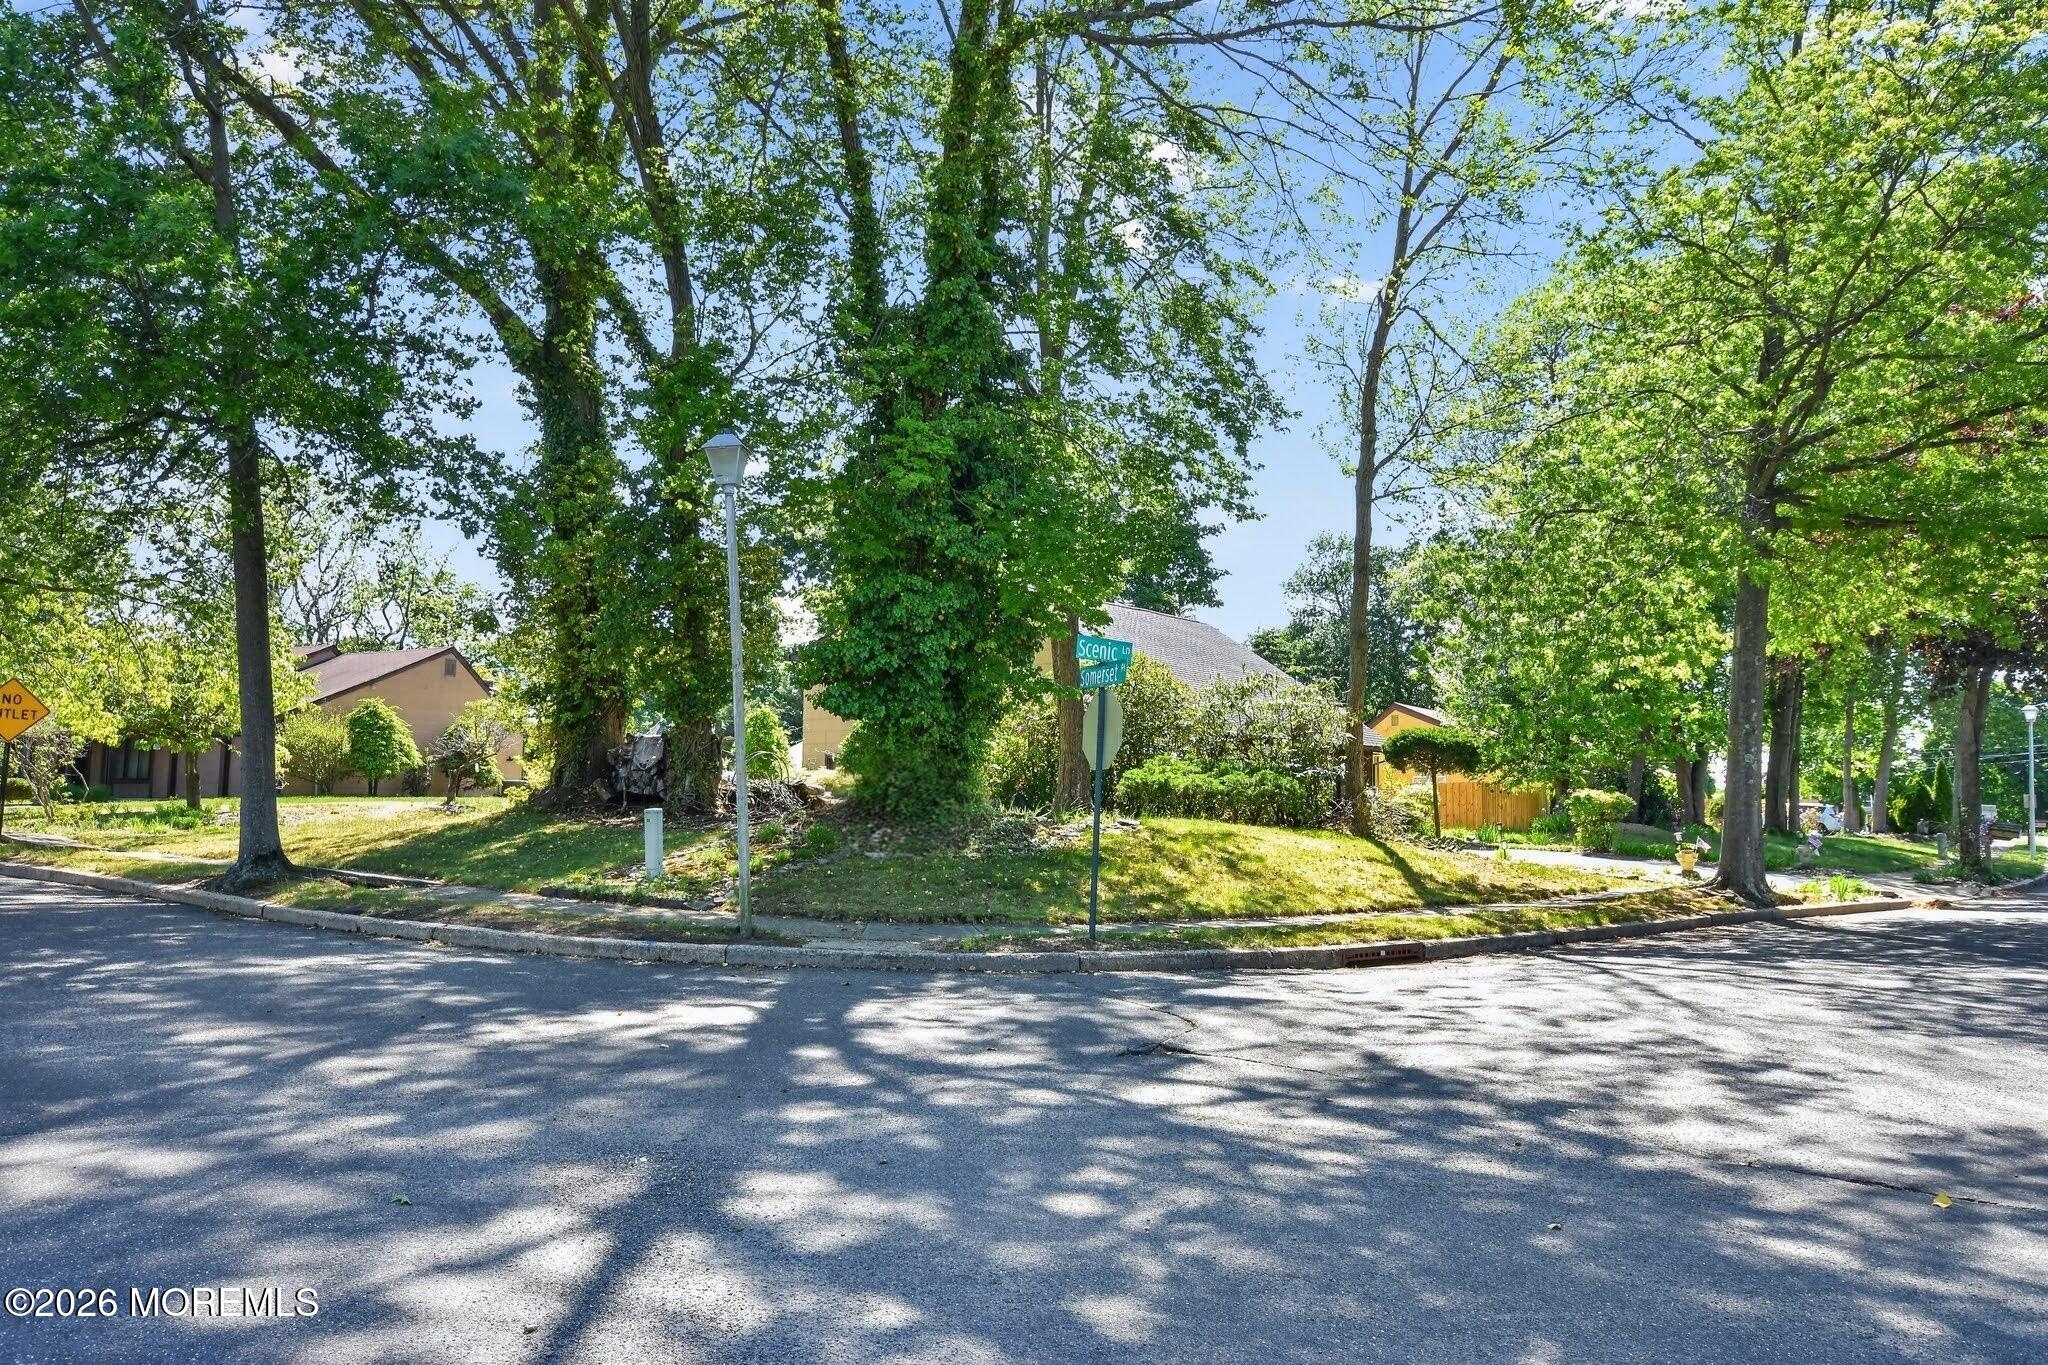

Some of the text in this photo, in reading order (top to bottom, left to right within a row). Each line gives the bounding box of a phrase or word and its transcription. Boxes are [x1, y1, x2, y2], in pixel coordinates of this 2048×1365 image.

[1078, 639, 1131, 661] Scenic Ln
[1080, 664, 1118, 687] Somerset
[2, 693, 22, 705] NO
